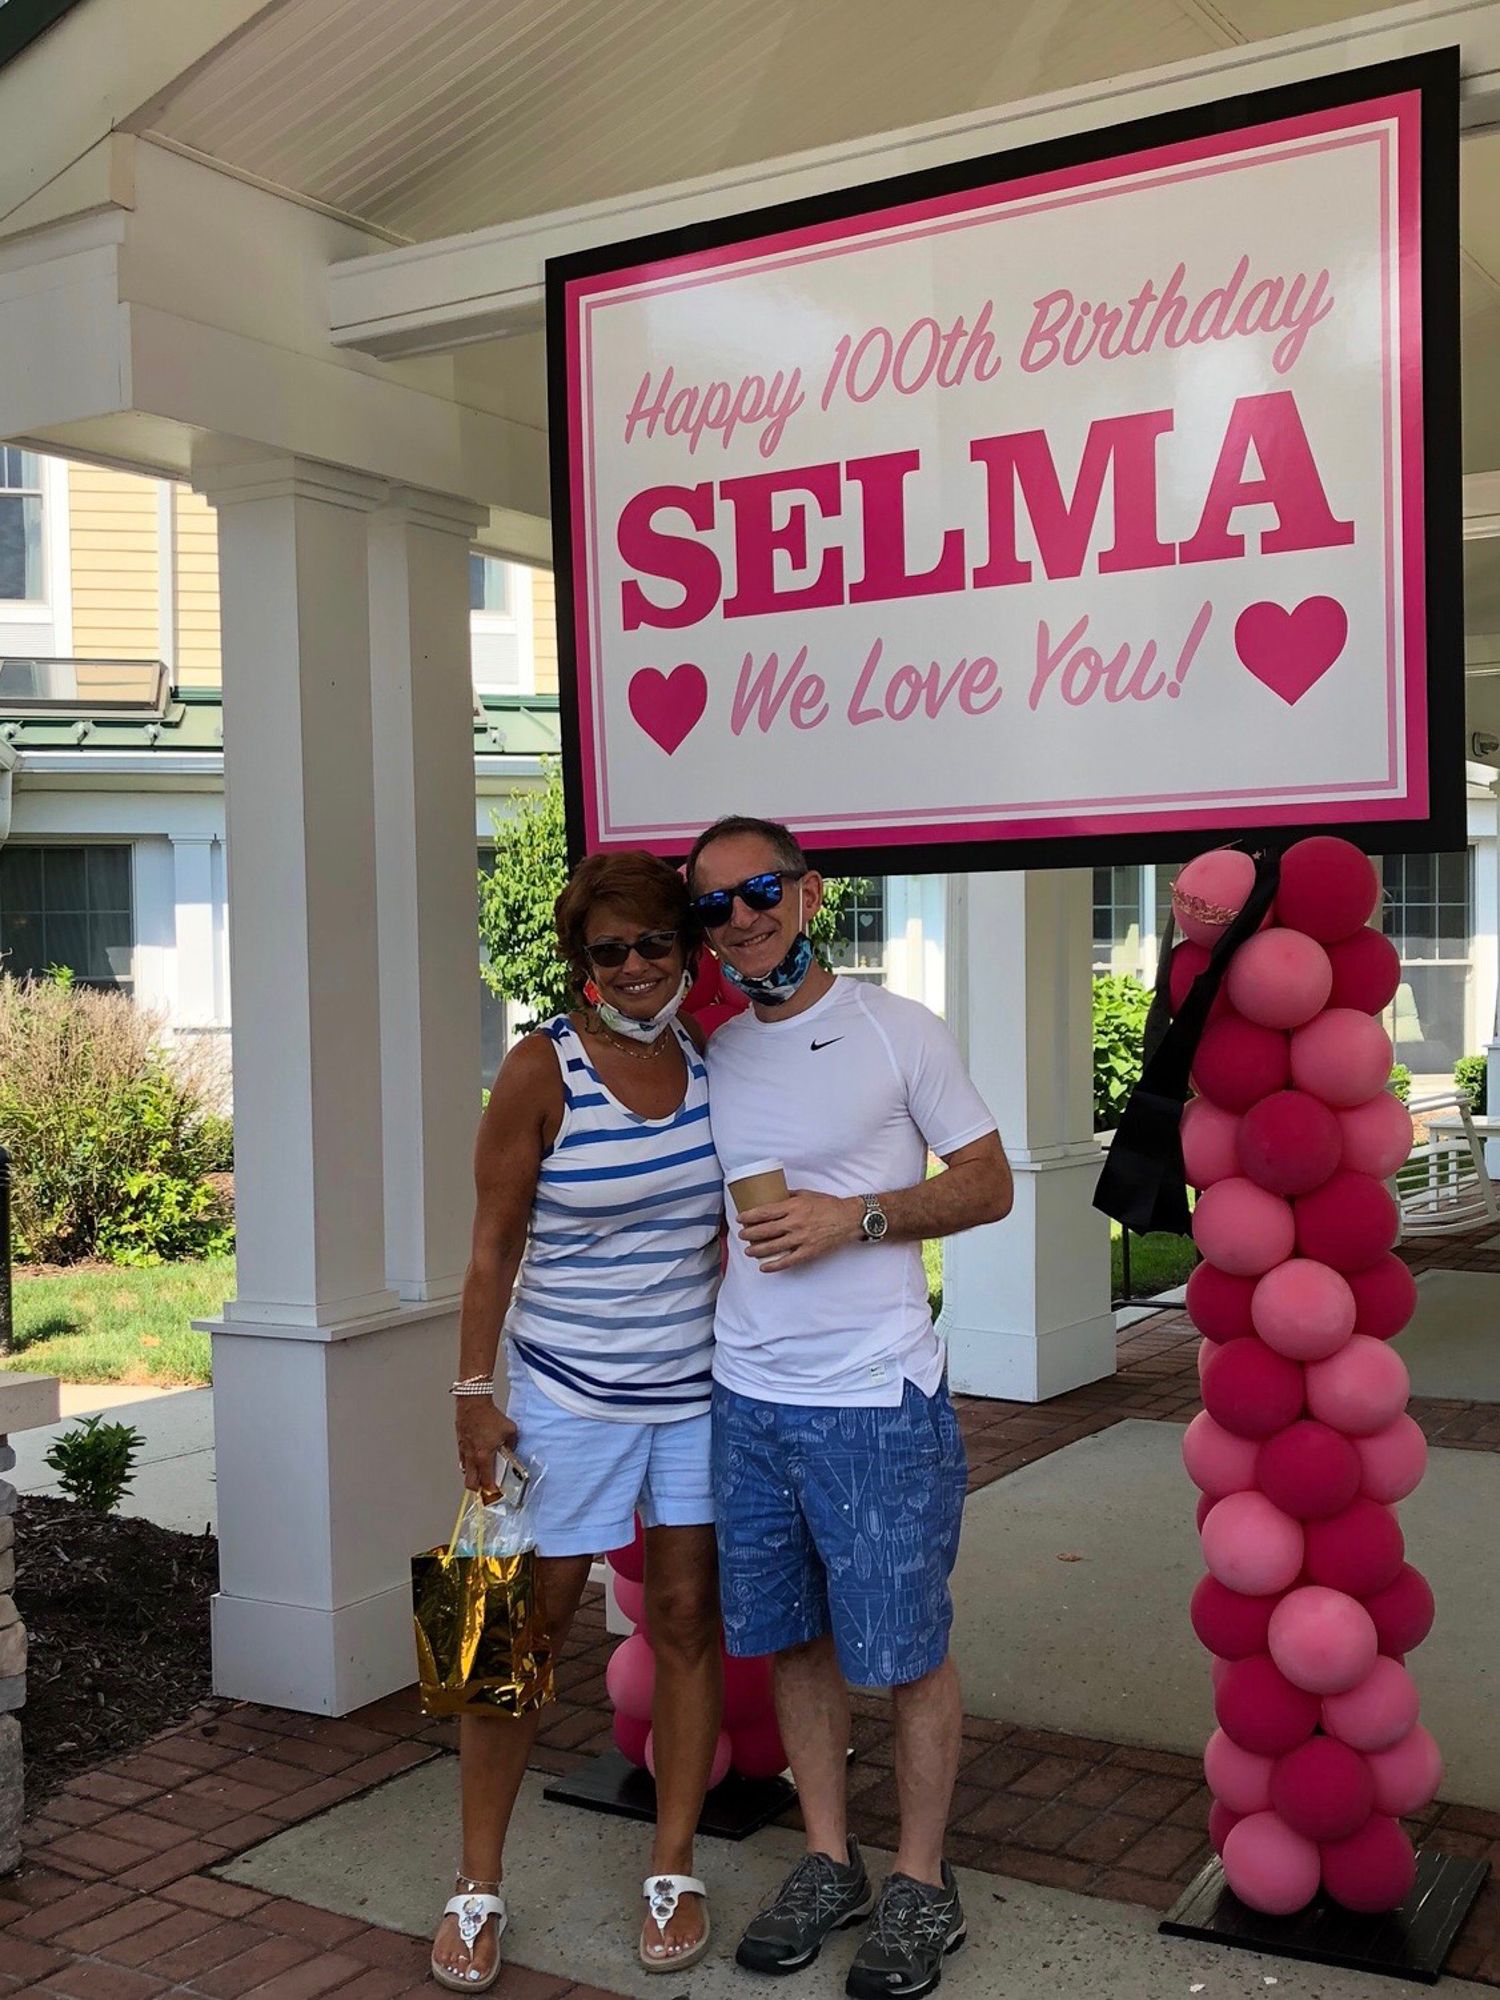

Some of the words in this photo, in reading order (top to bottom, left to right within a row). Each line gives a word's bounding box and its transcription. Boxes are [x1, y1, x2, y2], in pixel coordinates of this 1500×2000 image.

[624, 367, 805, 458] Happy
[821, 302, 1001, 411] 100th
[1019, 255, 1334, 374] Birthday
[615, 389, 1356, 632] SELMA
[730, 646, 829, 736] We
[847, 638, 1002, 726] Love
[1028, 602, 1212, 710] You!
